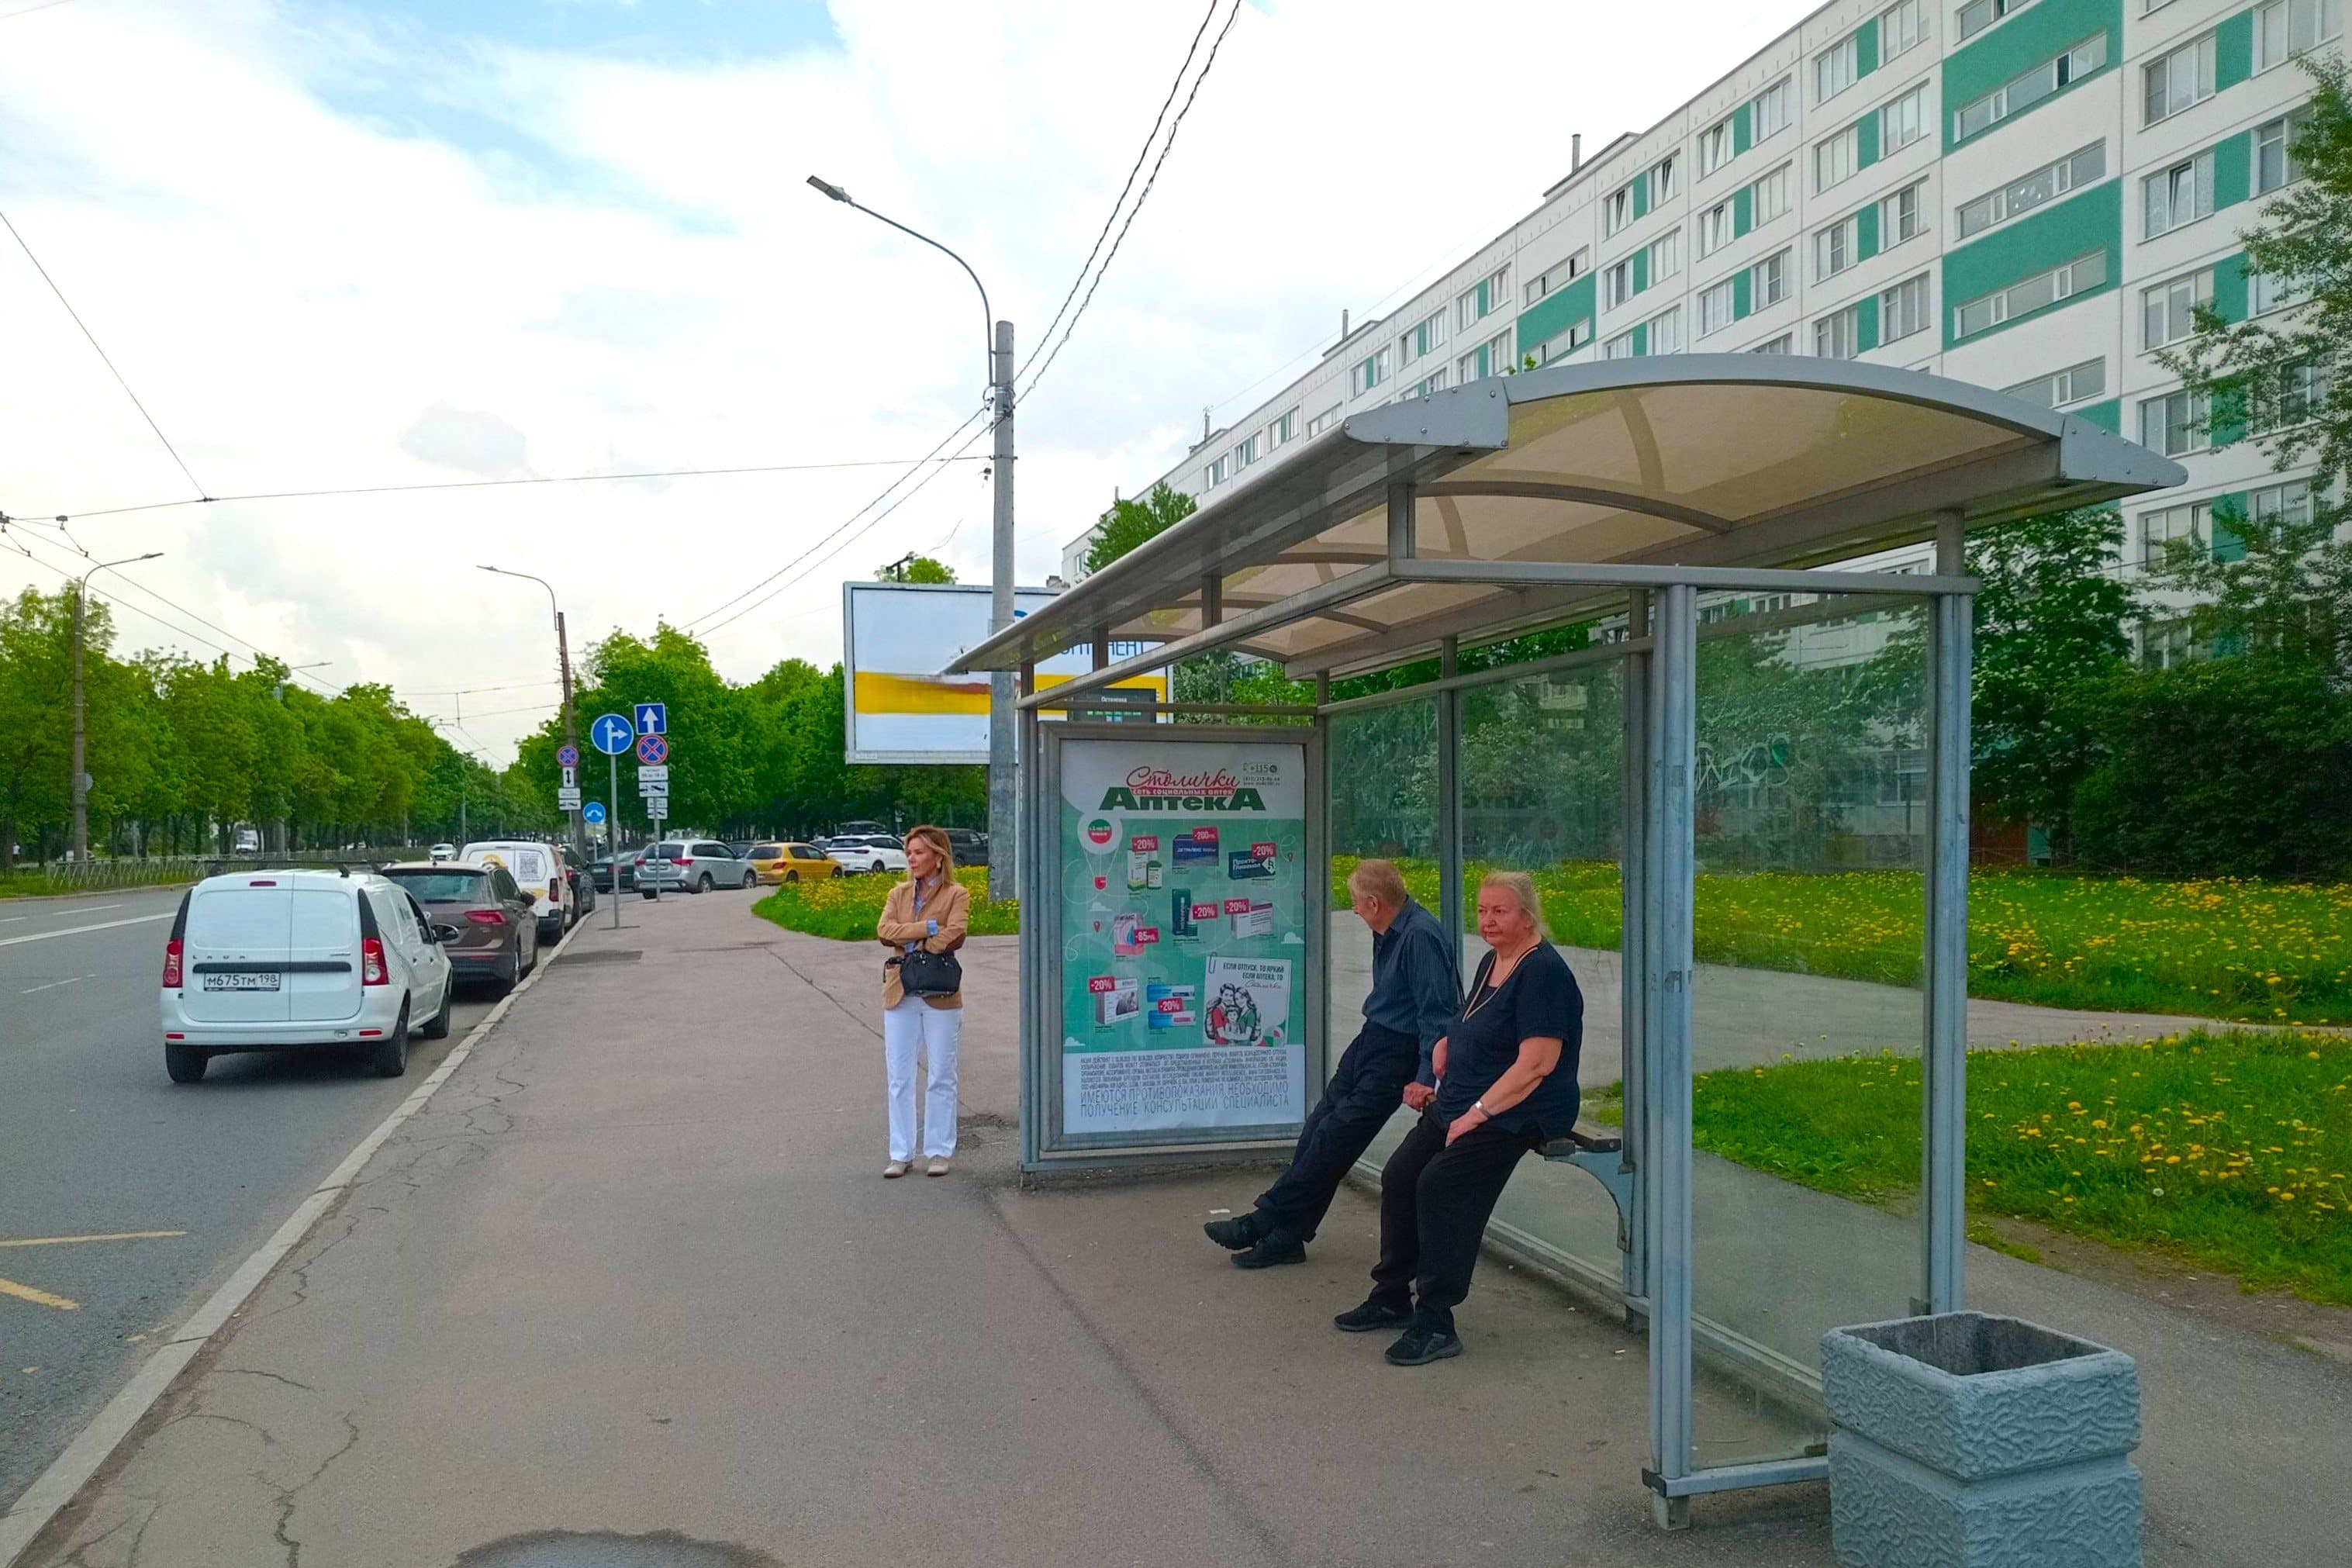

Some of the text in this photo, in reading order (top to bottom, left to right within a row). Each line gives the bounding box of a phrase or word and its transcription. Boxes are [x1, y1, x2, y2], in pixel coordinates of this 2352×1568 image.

[1126, 765, 1240, 788] Столички
[1134, 839, 1155, 849] -20%
[1253, 845, 1273, 856] -20%
[1194, 907, 1214, 917] -20%
[1226, 901, 1247, 912] -20%
[258, 974, 278, 983] 198
[1091, 979, 1112, 990] -20%
[1159, 1000, 1180, 1011] -20%
[1080, 1089, 1126, 1103] ИМЕЮТСЯ
[1228, 1081, 1288, 1095] НЕОБХОДИМО
[1080, 1094, 1289, 1117] ПОЛУЧЕНИЕ КОНСУЛЬТАЦИИ СПЕЦИАЛИСТА
